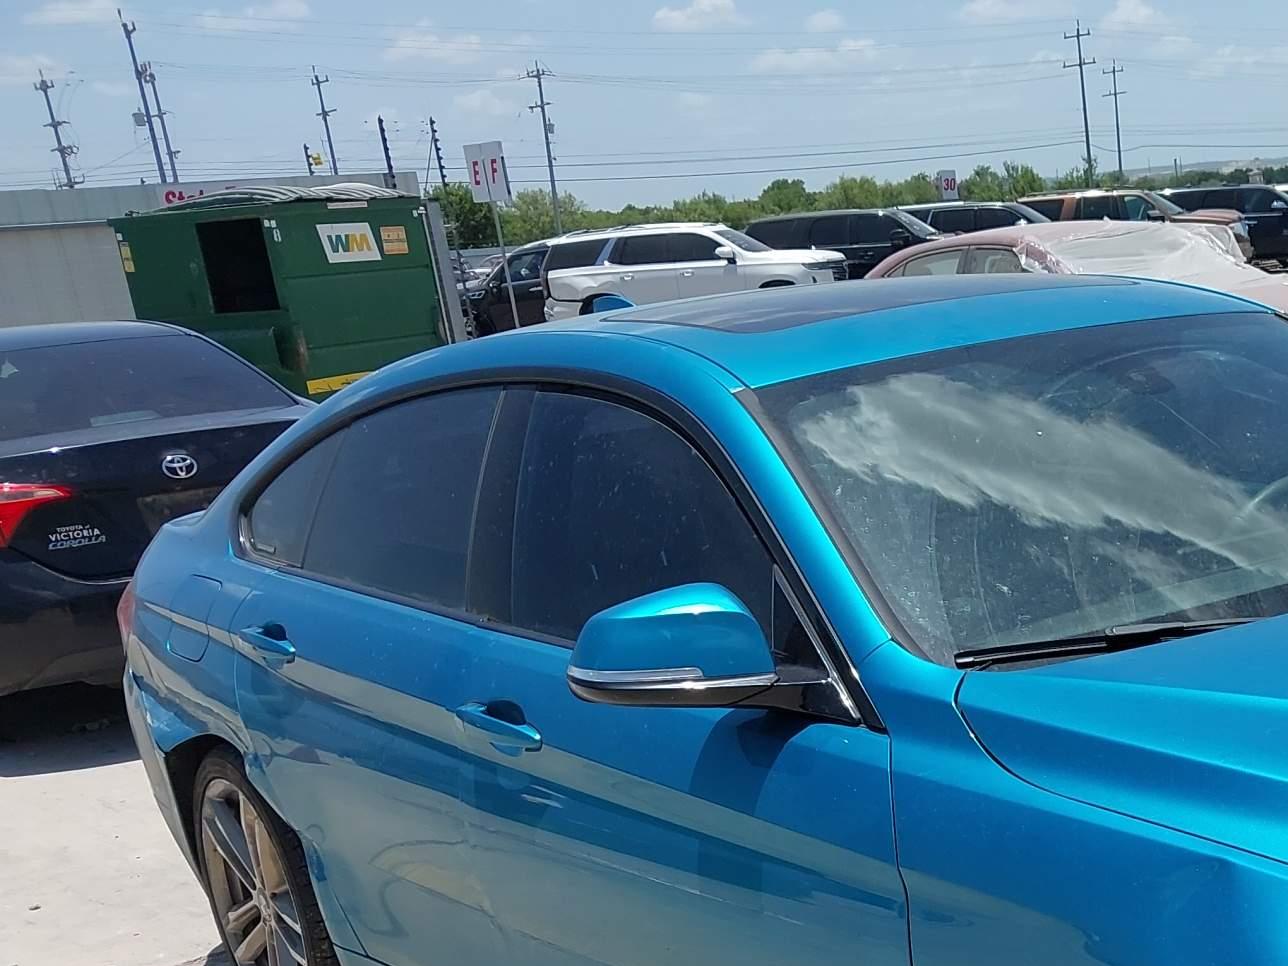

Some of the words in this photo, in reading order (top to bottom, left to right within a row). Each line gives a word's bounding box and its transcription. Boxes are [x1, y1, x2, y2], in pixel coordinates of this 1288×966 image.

[472, 160, 481, 186] E
[490, 158, 498, 185] F
[943, 177, 956, 191] 30
[326, 232, 371, 253] WM
[48, 528, 101, 541] VICTORIA
[48, 535, 106, 550] COROLLA
